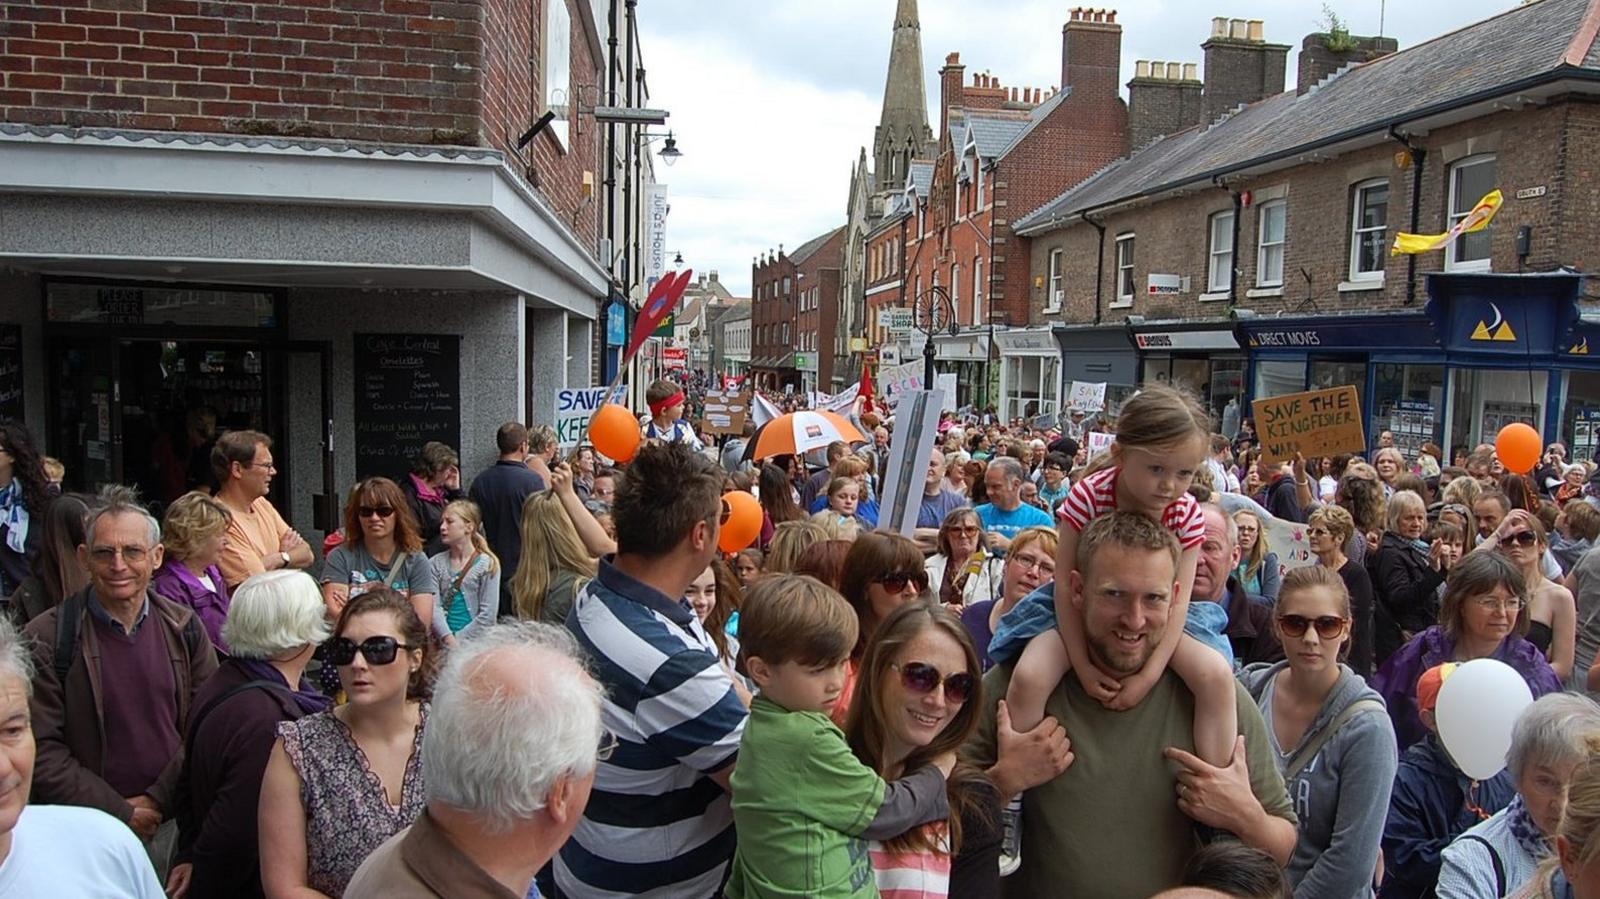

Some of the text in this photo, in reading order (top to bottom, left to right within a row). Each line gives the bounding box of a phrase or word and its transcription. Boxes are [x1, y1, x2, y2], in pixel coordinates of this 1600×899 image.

[652, 193, 665, 270] Julia's House
[102, 287, 142, 302] PLEASE
[106, 302, 140, 314] ORDER
[891, 320, 912, 329] SHOP
[1258, 330, 1321, 346] DIRECT MOVES
[558, 389, 607, 411] SAVE
[1263, 391, 1350, 424] SAVE THE
[557, 416, 590, 444] KEE
[1266, 411, 1356, 440] KINGFISHER
[1289, 550, 1309, 561] AND
